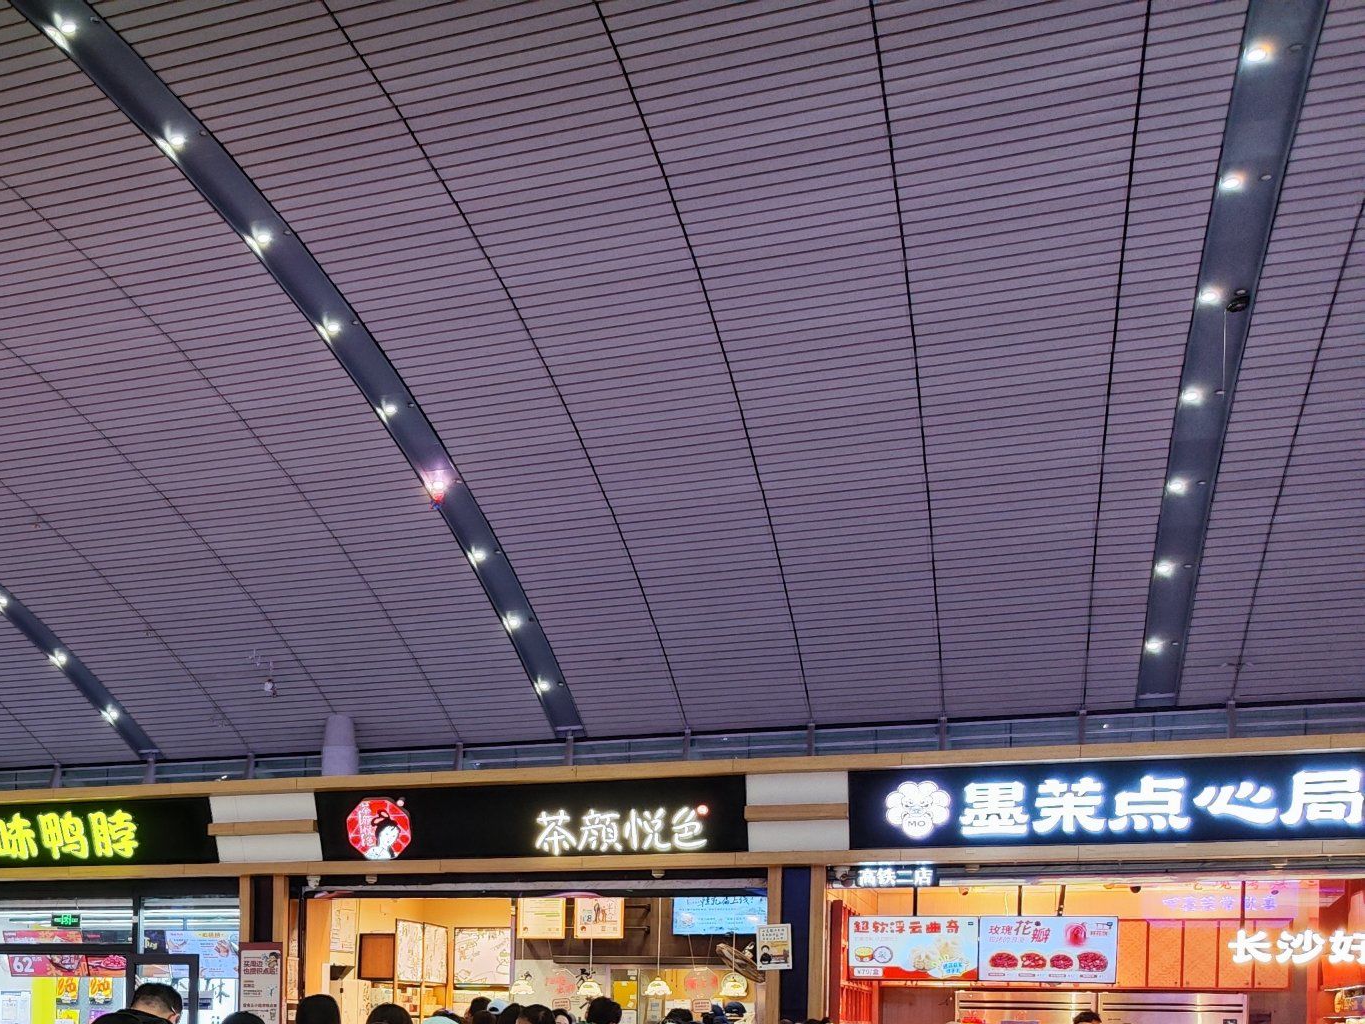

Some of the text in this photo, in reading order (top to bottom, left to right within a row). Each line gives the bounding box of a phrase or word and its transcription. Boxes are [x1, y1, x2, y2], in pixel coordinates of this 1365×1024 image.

[959, 769, 1365, 838] 墨茉点心局
[907, 819, 927, 828] MO
[857, 867, 933, 887] 高铁二店
[854, 920, 960, 935] 超软浮云曲奇
[13, 956, 35, 973] 62
